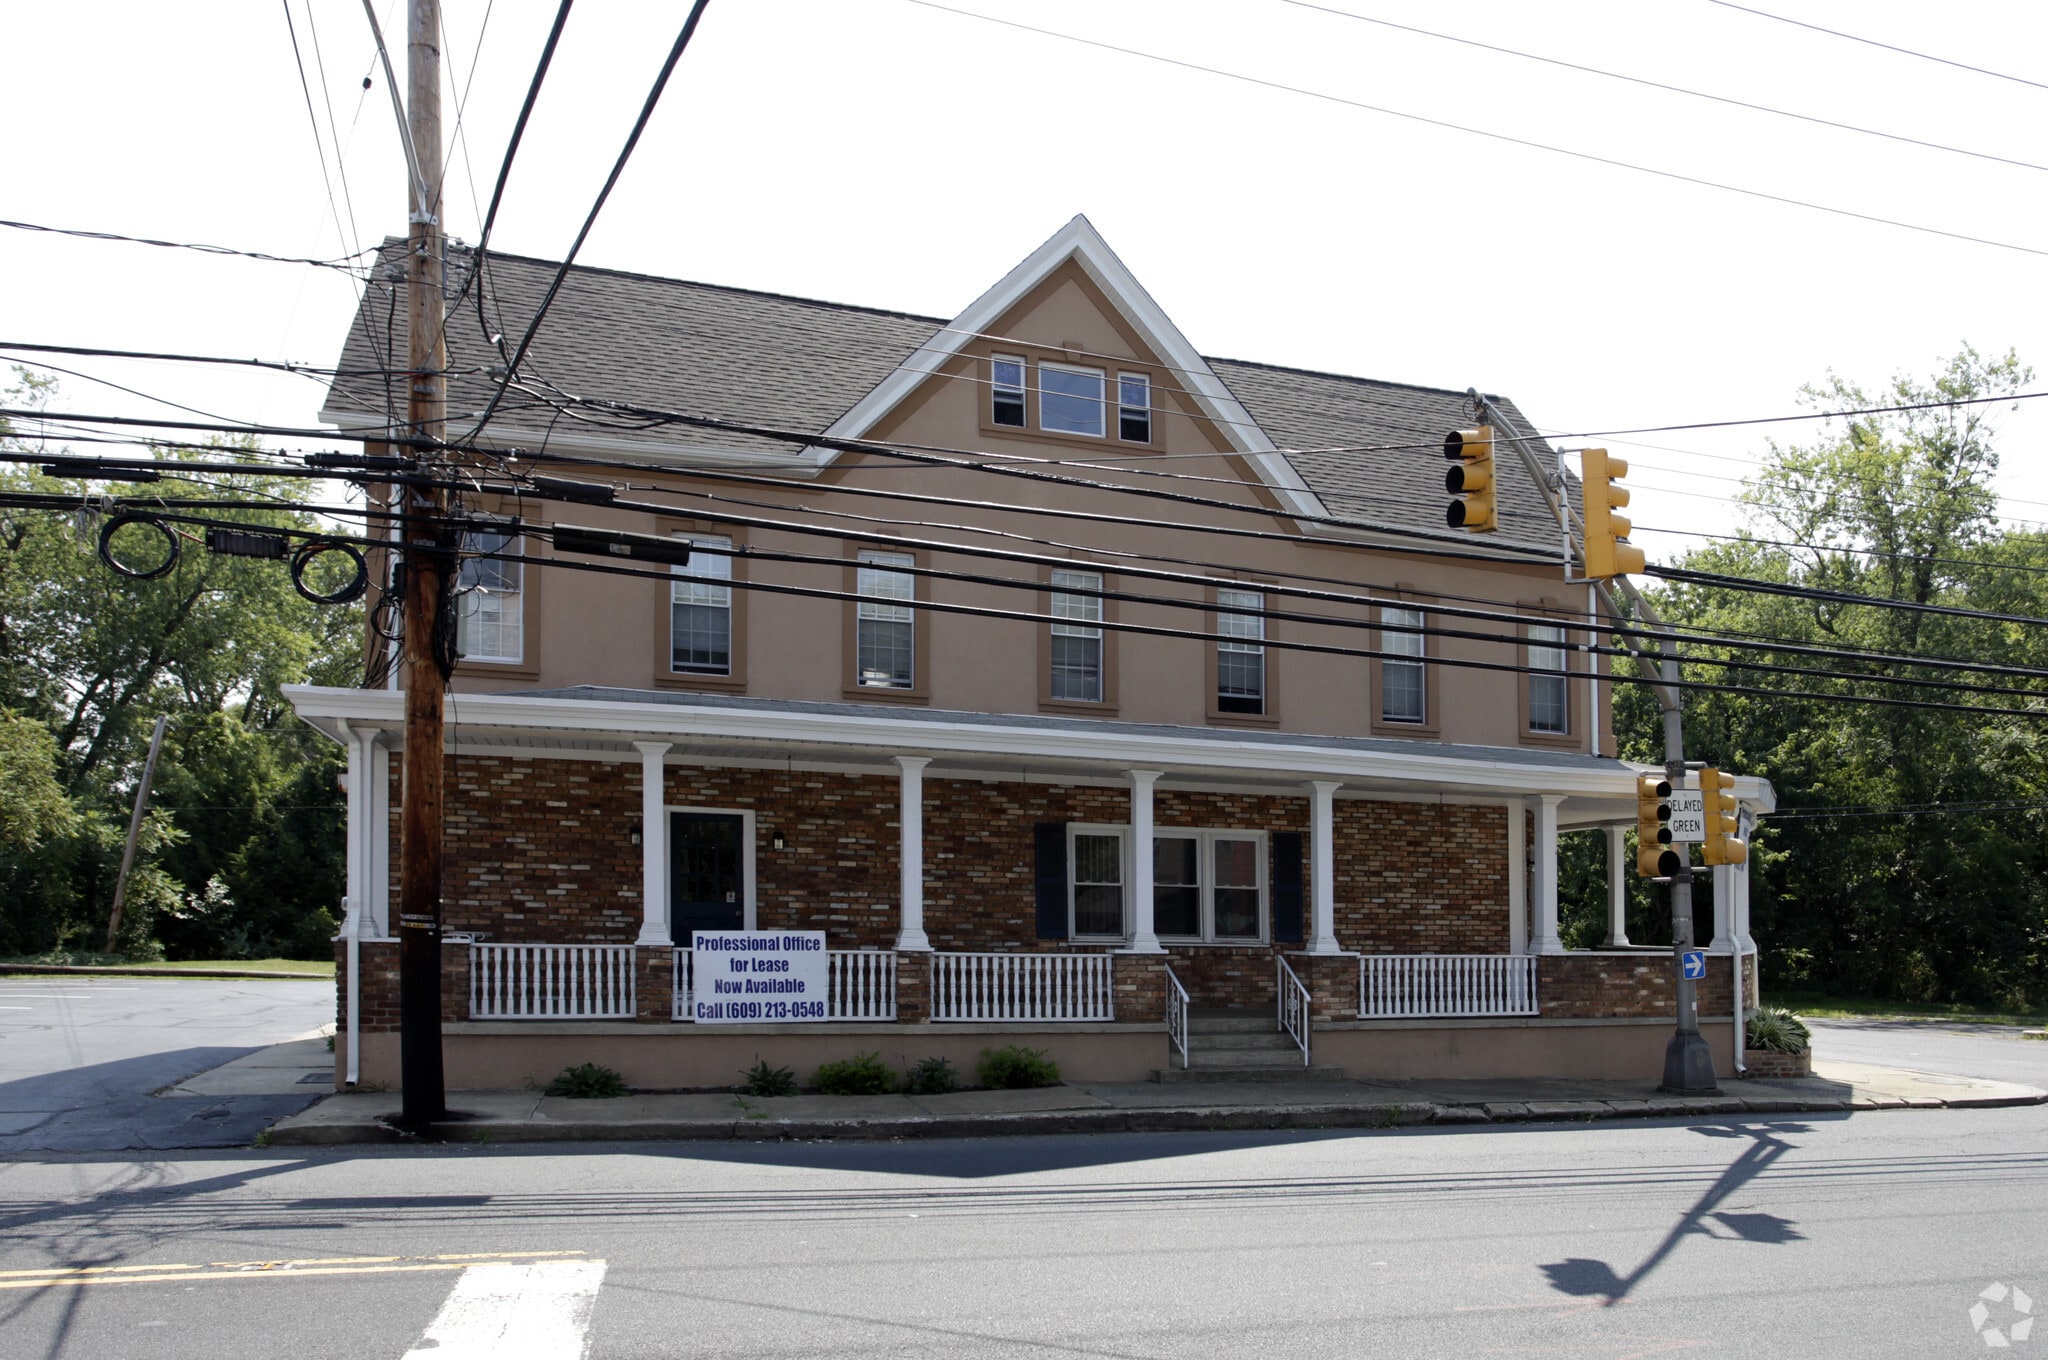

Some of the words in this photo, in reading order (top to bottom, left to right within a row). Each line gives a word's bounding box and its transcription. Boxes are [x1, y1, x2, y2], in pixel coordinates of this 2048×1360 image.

[1667, 799, 1702, 811] DELAYED
[1673, 820, 1700, 832] GREEN
[696, 936, 780, 951] Professional
[783, 936, 820, 951] Office
[730, 958, 749, 972] for
[752, 958, 789, 972] Lease
[714, 979, 742, 994] Now
[745, 978, 805, 993] Available
[697, 1002, 723, 1019] Call
[726, 1002, 762, 1019] (609)
[764, 1001, 824, 1018] 213-0548
